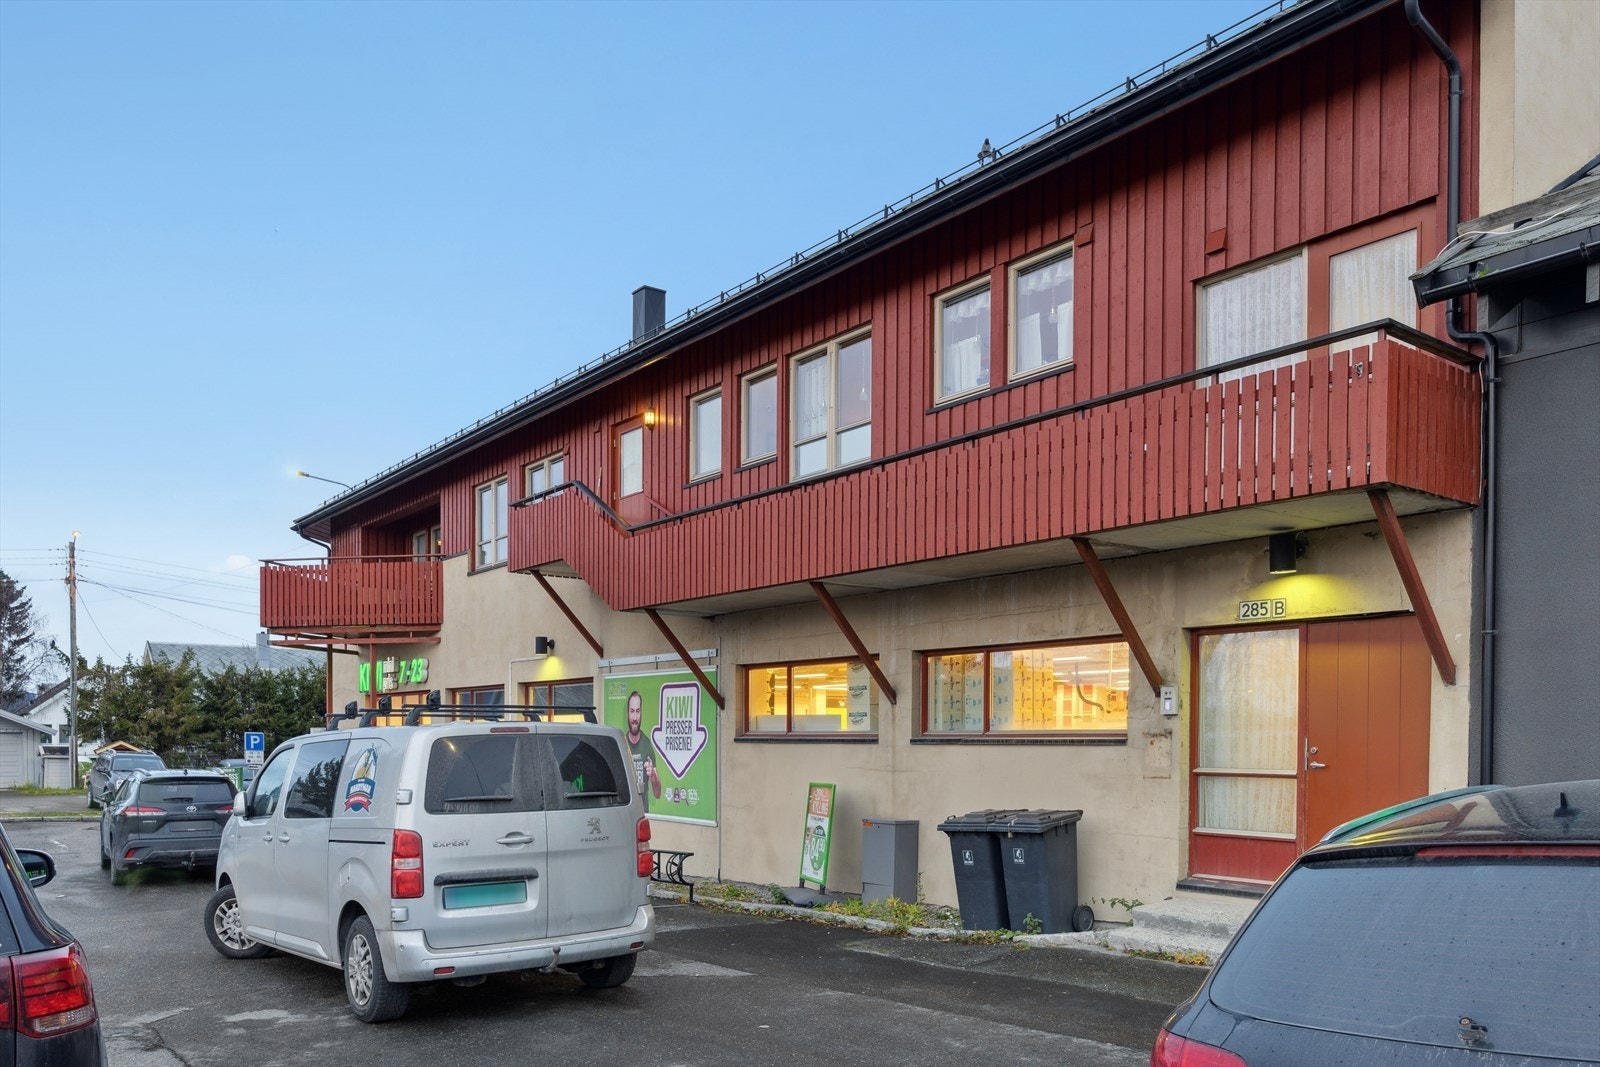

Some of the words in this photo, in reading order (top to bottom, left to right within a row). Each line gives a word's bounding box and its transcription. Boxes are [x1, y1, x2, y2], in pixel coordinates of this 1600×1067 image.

[1241, 601, 1268, 618] 285
[1274, 601, 1284, 616] B
[399, 658, 423, 683] 7-23
[666, 695, 693, 719] KIWI
[665, 720, 692, 735] PRESSER
[250, 735, 260, 749] P
[665, 736, 692, 751] PRISENE!
[432, 839, 470, 848] EXPERT
